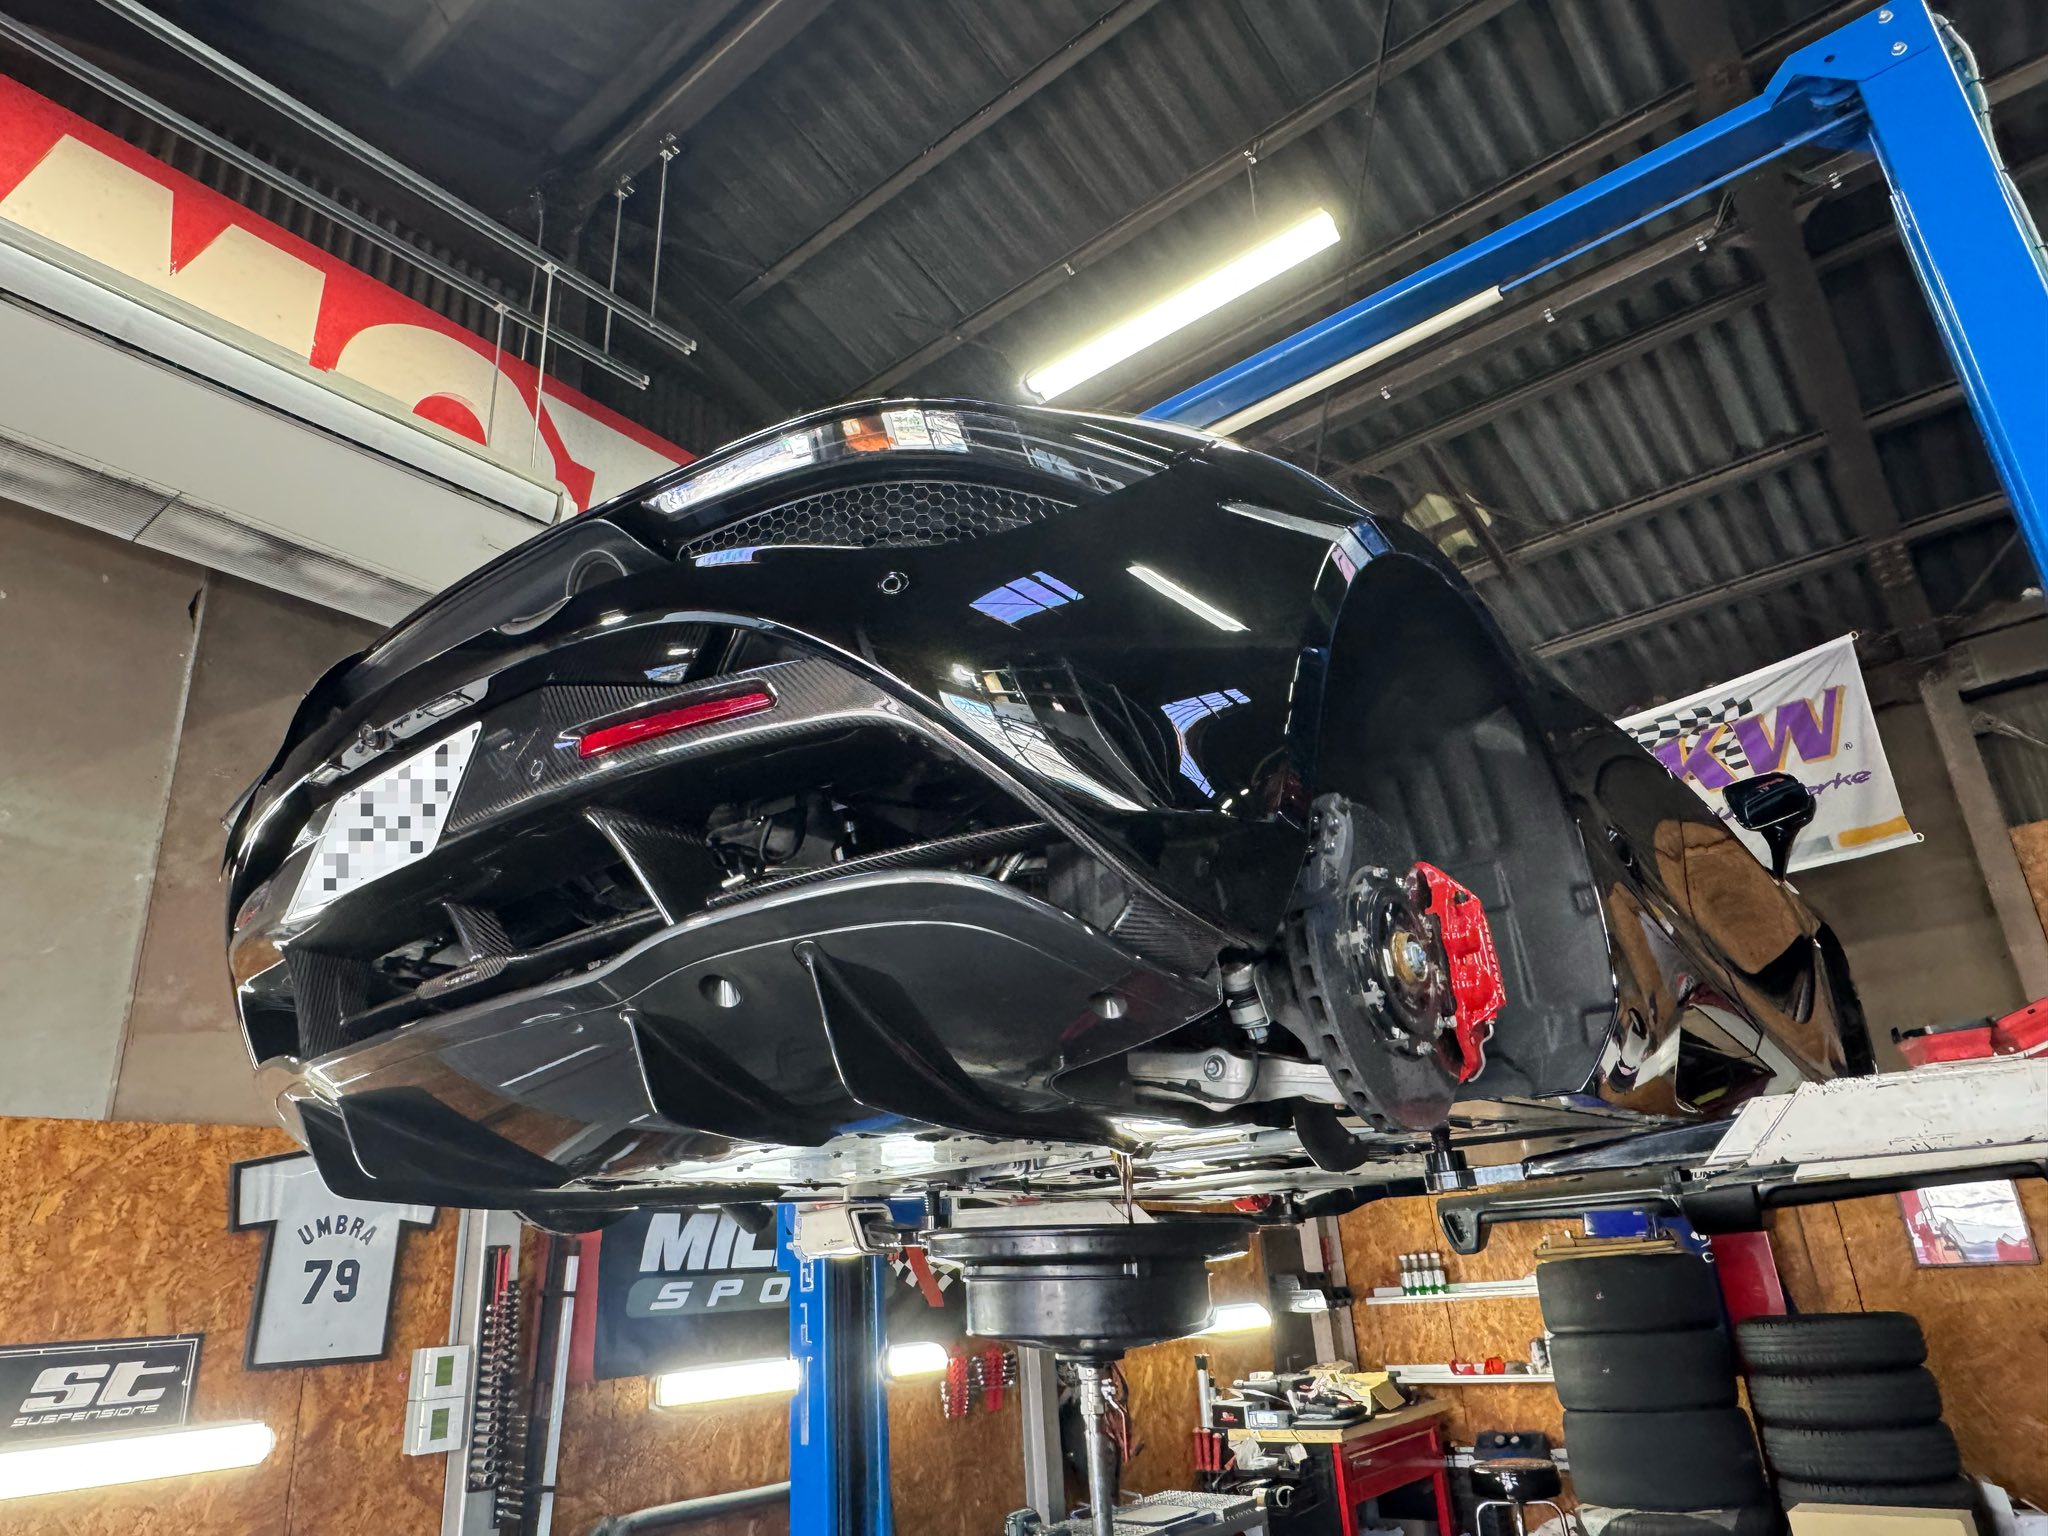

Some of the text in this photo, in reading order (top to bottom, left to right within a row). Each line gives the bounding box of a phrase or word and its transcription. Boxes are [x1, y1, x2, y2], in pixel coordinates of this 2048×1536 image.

[297, 1214, 377, 1246] UMBRA
[639, 1212, 778, 1273] MIL
[301, 1259, 361, 1305] 79
